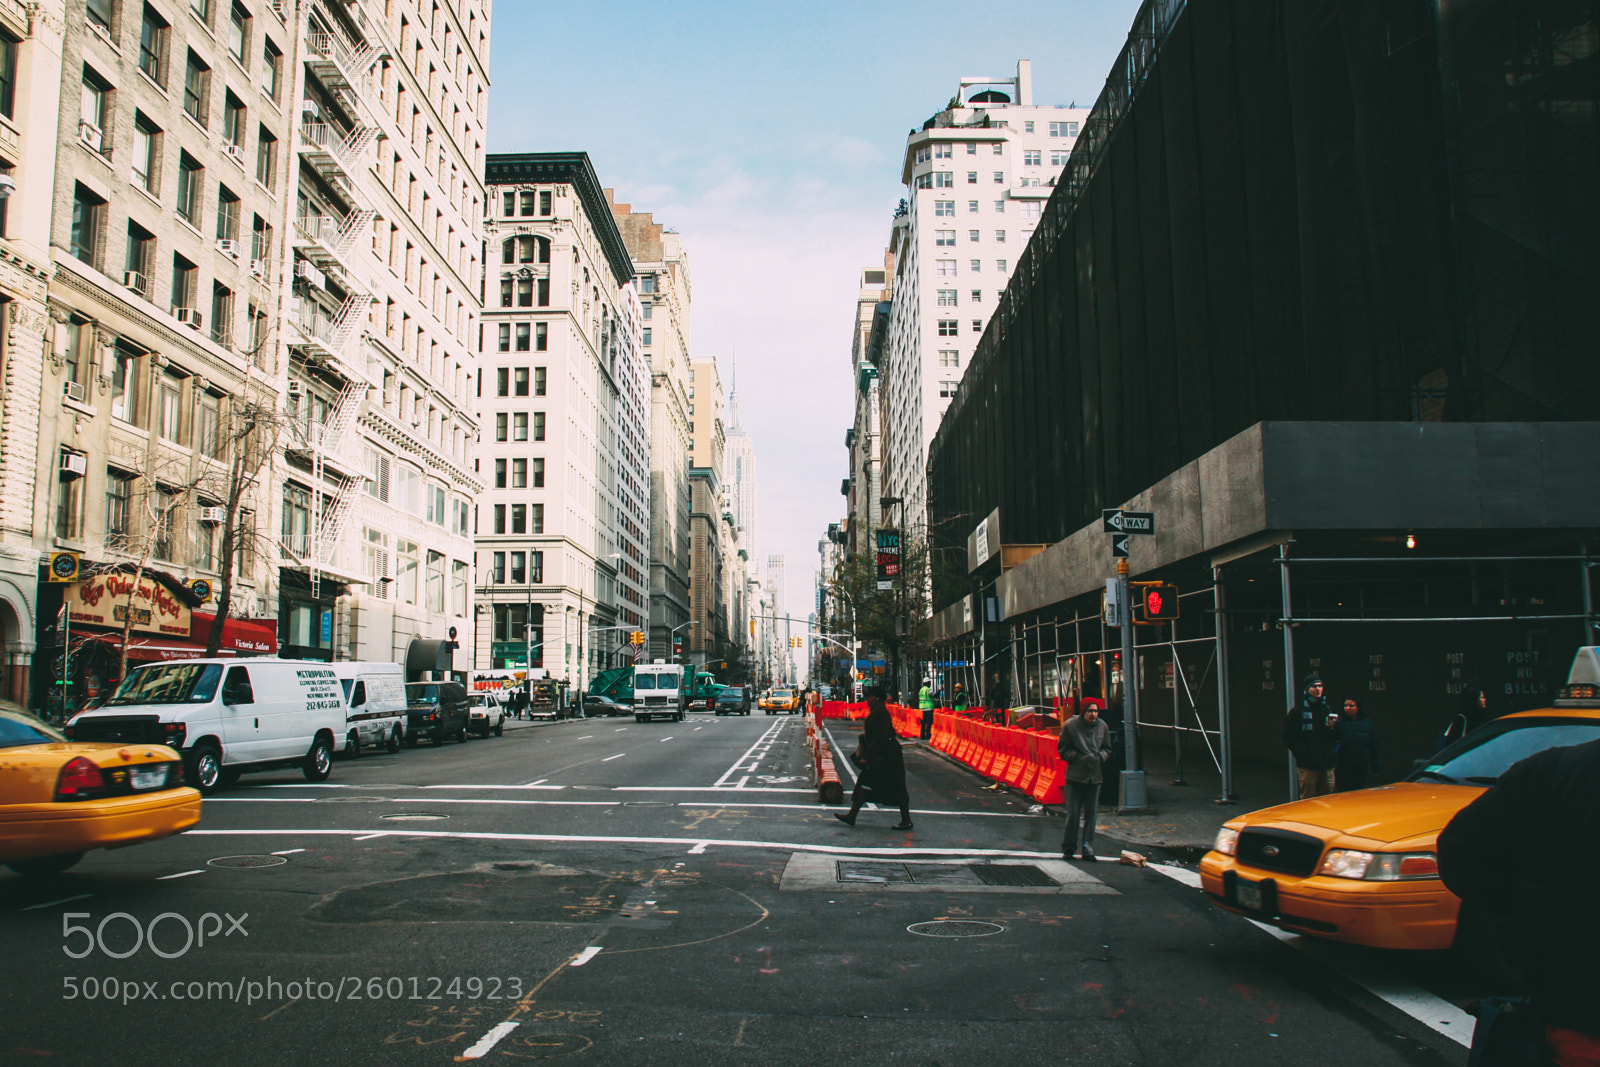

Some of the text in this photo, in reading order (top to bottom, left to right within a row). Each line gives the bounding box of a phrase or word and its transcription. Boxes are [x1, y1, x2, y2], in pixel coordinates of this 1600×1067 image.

[1126, 518, 1146, 528] WAY
[877, 533, 899, 547] NYC
[235, 638, 269, 651] Victoria Salon
[1369, 654, 1384, 665] POST
[1446, 653, 1464, 664] POST
[1506, 651, 1541, 664] POST
[1373, 668, 1382, 678] NO
[1451, 668, 1462, 678] NO
[1516, 667, 1533, 679] NO
[1369, 680, 1387, 691] BILLS
[1504, 683, 1548, 695] BILLS
